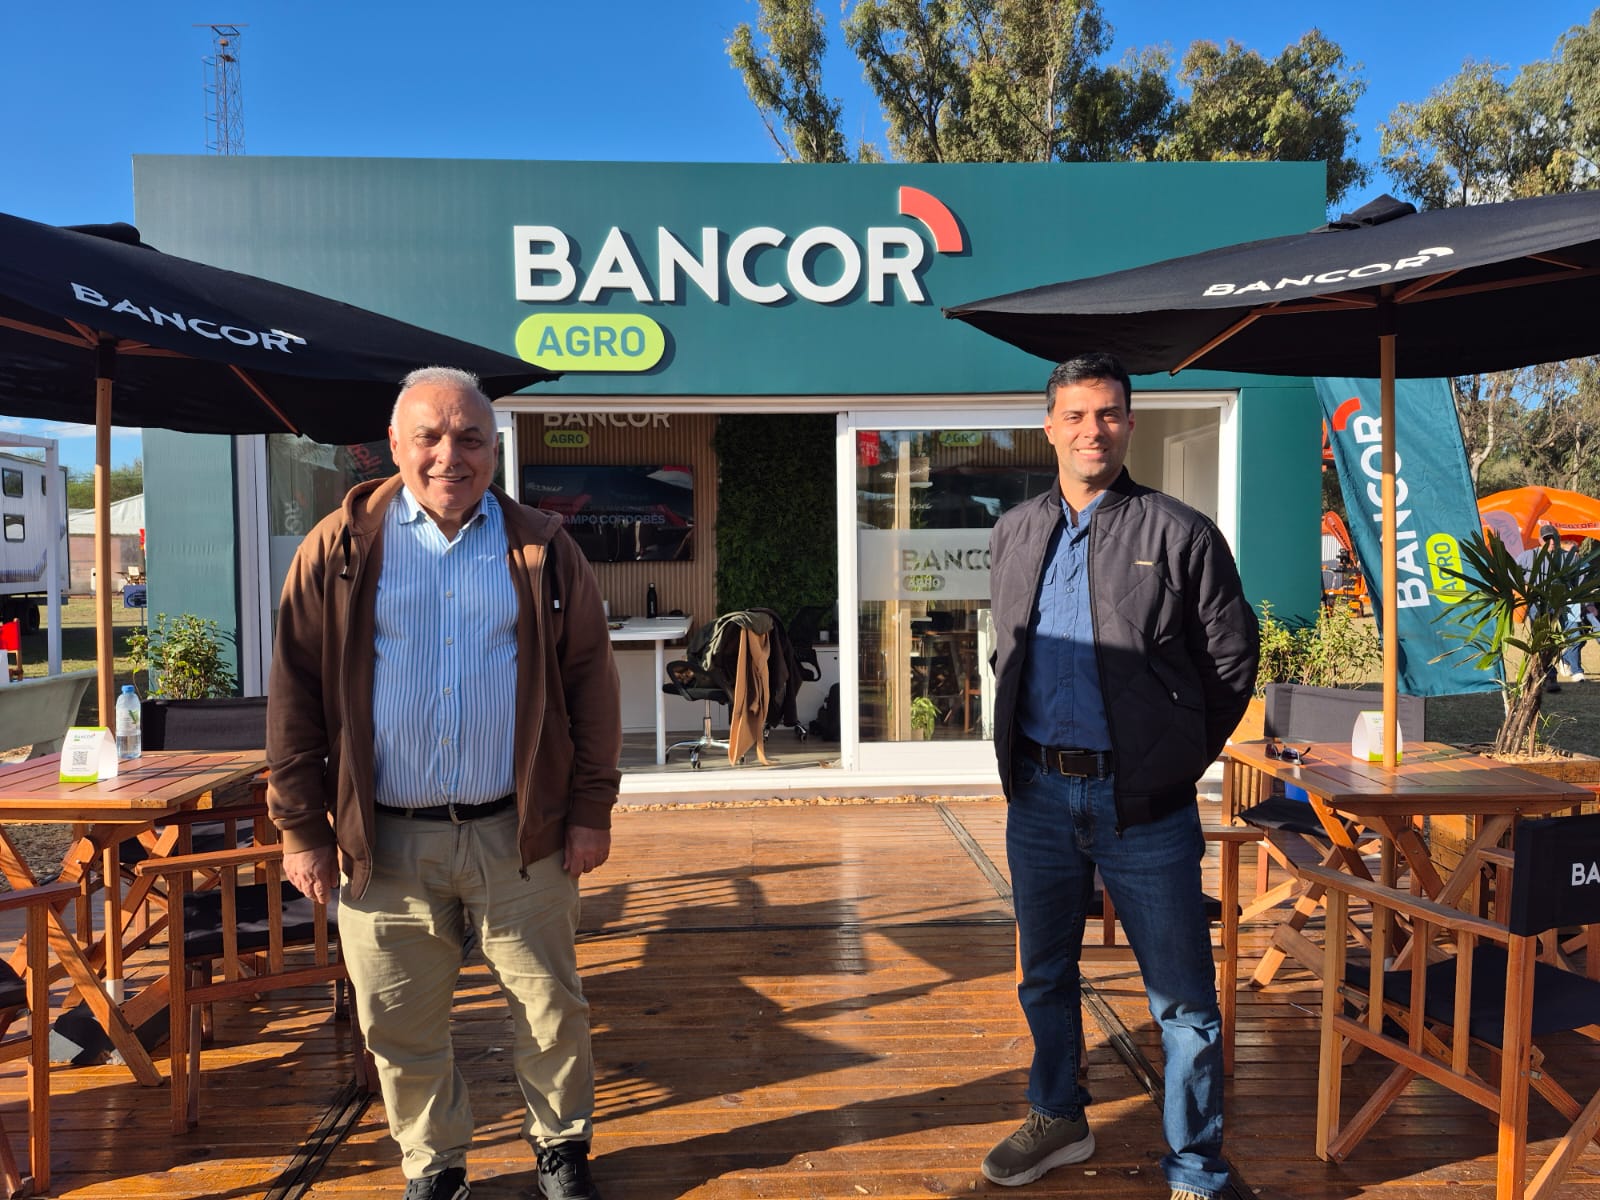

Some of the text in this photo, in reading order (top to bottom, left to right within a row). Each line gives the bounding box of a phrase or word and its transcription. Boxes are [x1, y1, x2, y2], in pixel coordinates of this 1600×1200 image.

[513, 225, 925, 304] BANCOR
[1203, 255, 1431, 296] BANCOR
[71, 282, 293, 354] BANCOR
[536, 326, 646, 357] AGRO
[544, 412, 670, 427] BANCOR
[550, 434, 584, 444] AGRO
[561, 514, 598, 525] AMPO
[1353, 415, 1431, 608] BANCOR
